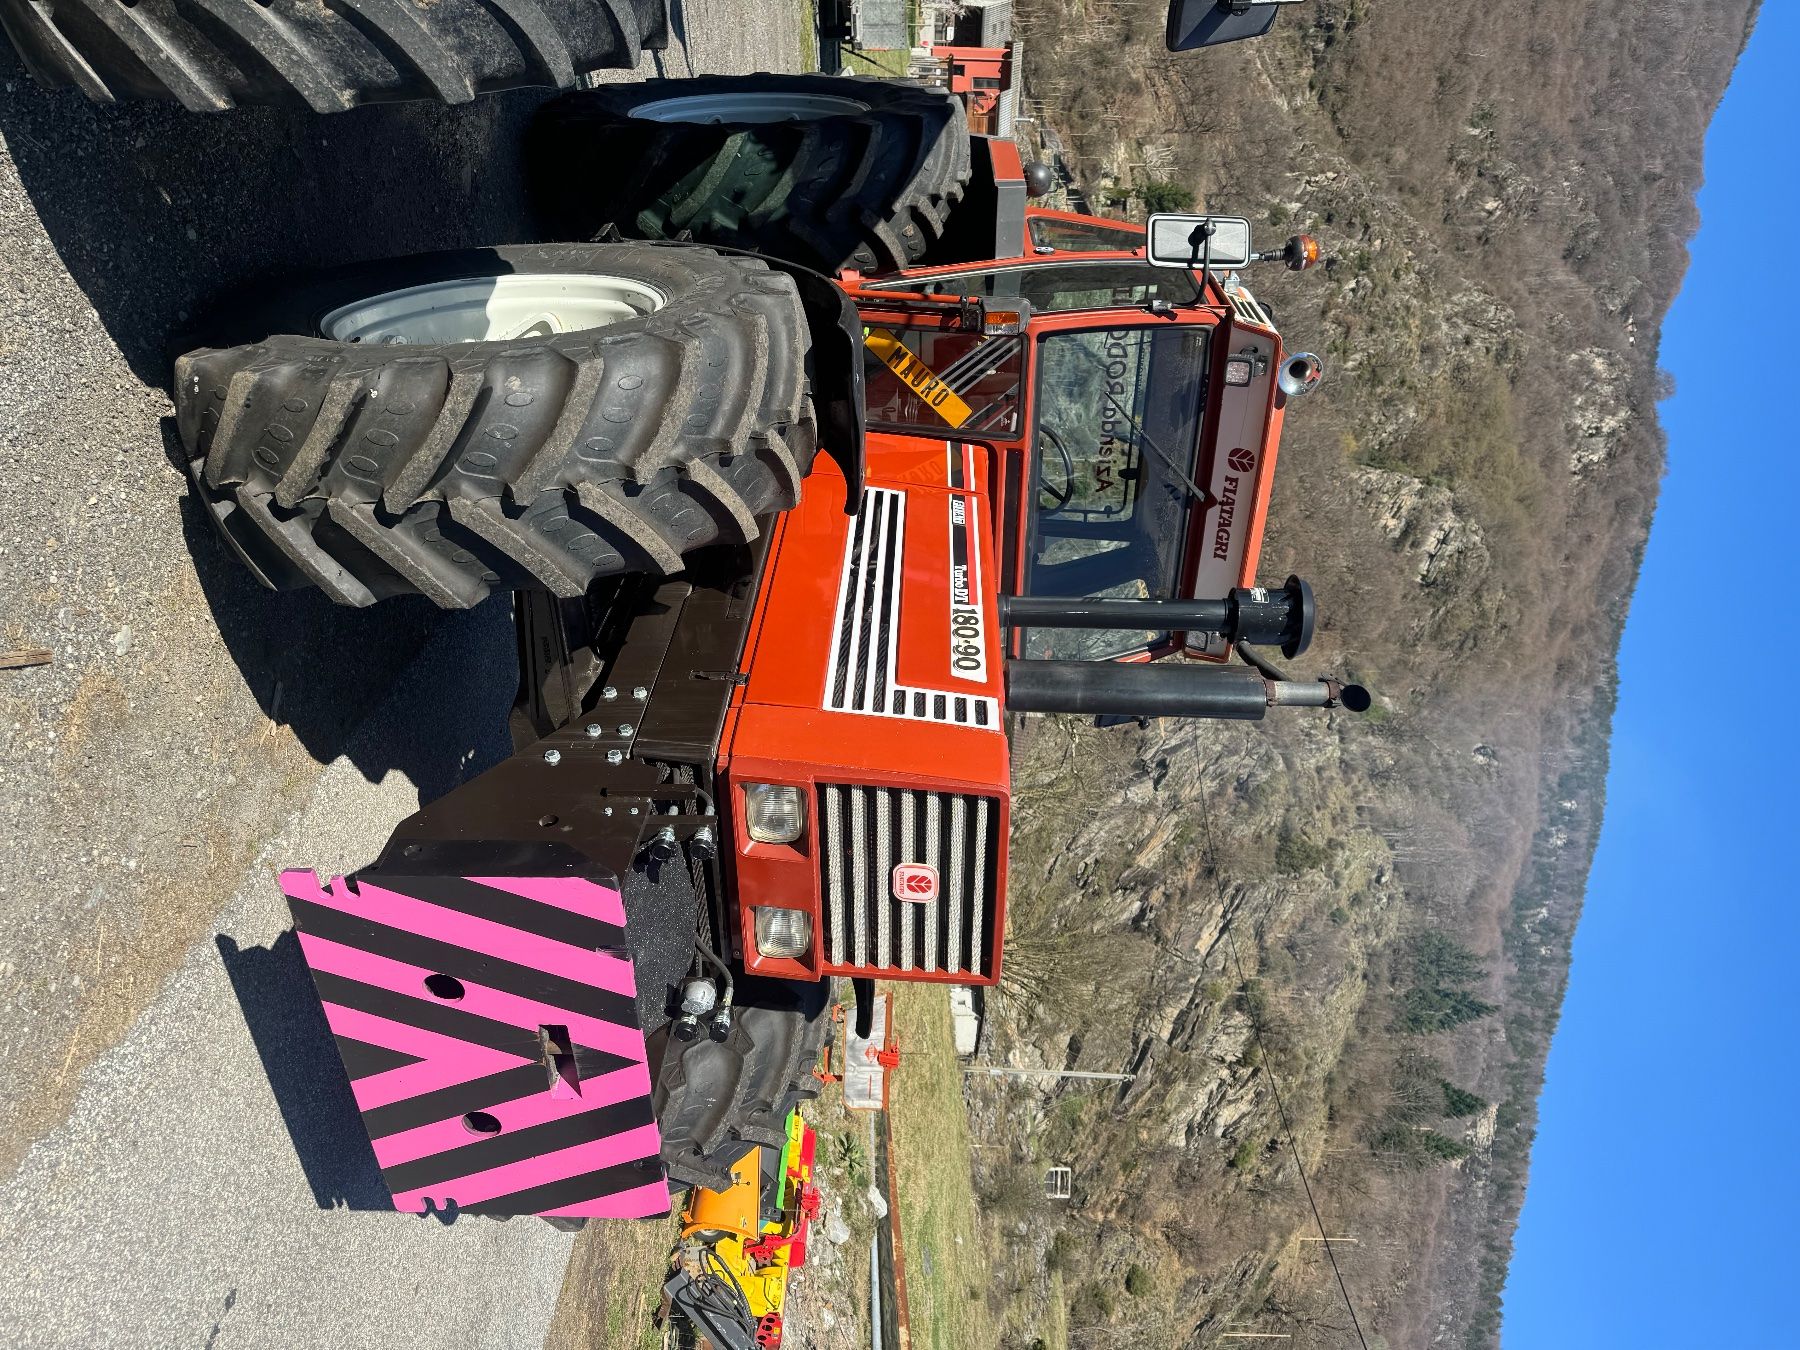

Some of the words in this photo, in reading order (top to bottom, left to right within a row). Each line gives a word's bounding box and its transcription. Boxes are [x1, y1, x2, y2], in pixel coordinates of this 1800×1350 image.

[886, 345, 951, 408] MAURO
[1213, 475, 1240, 561] FIATAGRI
[954, 564, 967, 588] Turbo
[954, 588, 968, 602] DT
